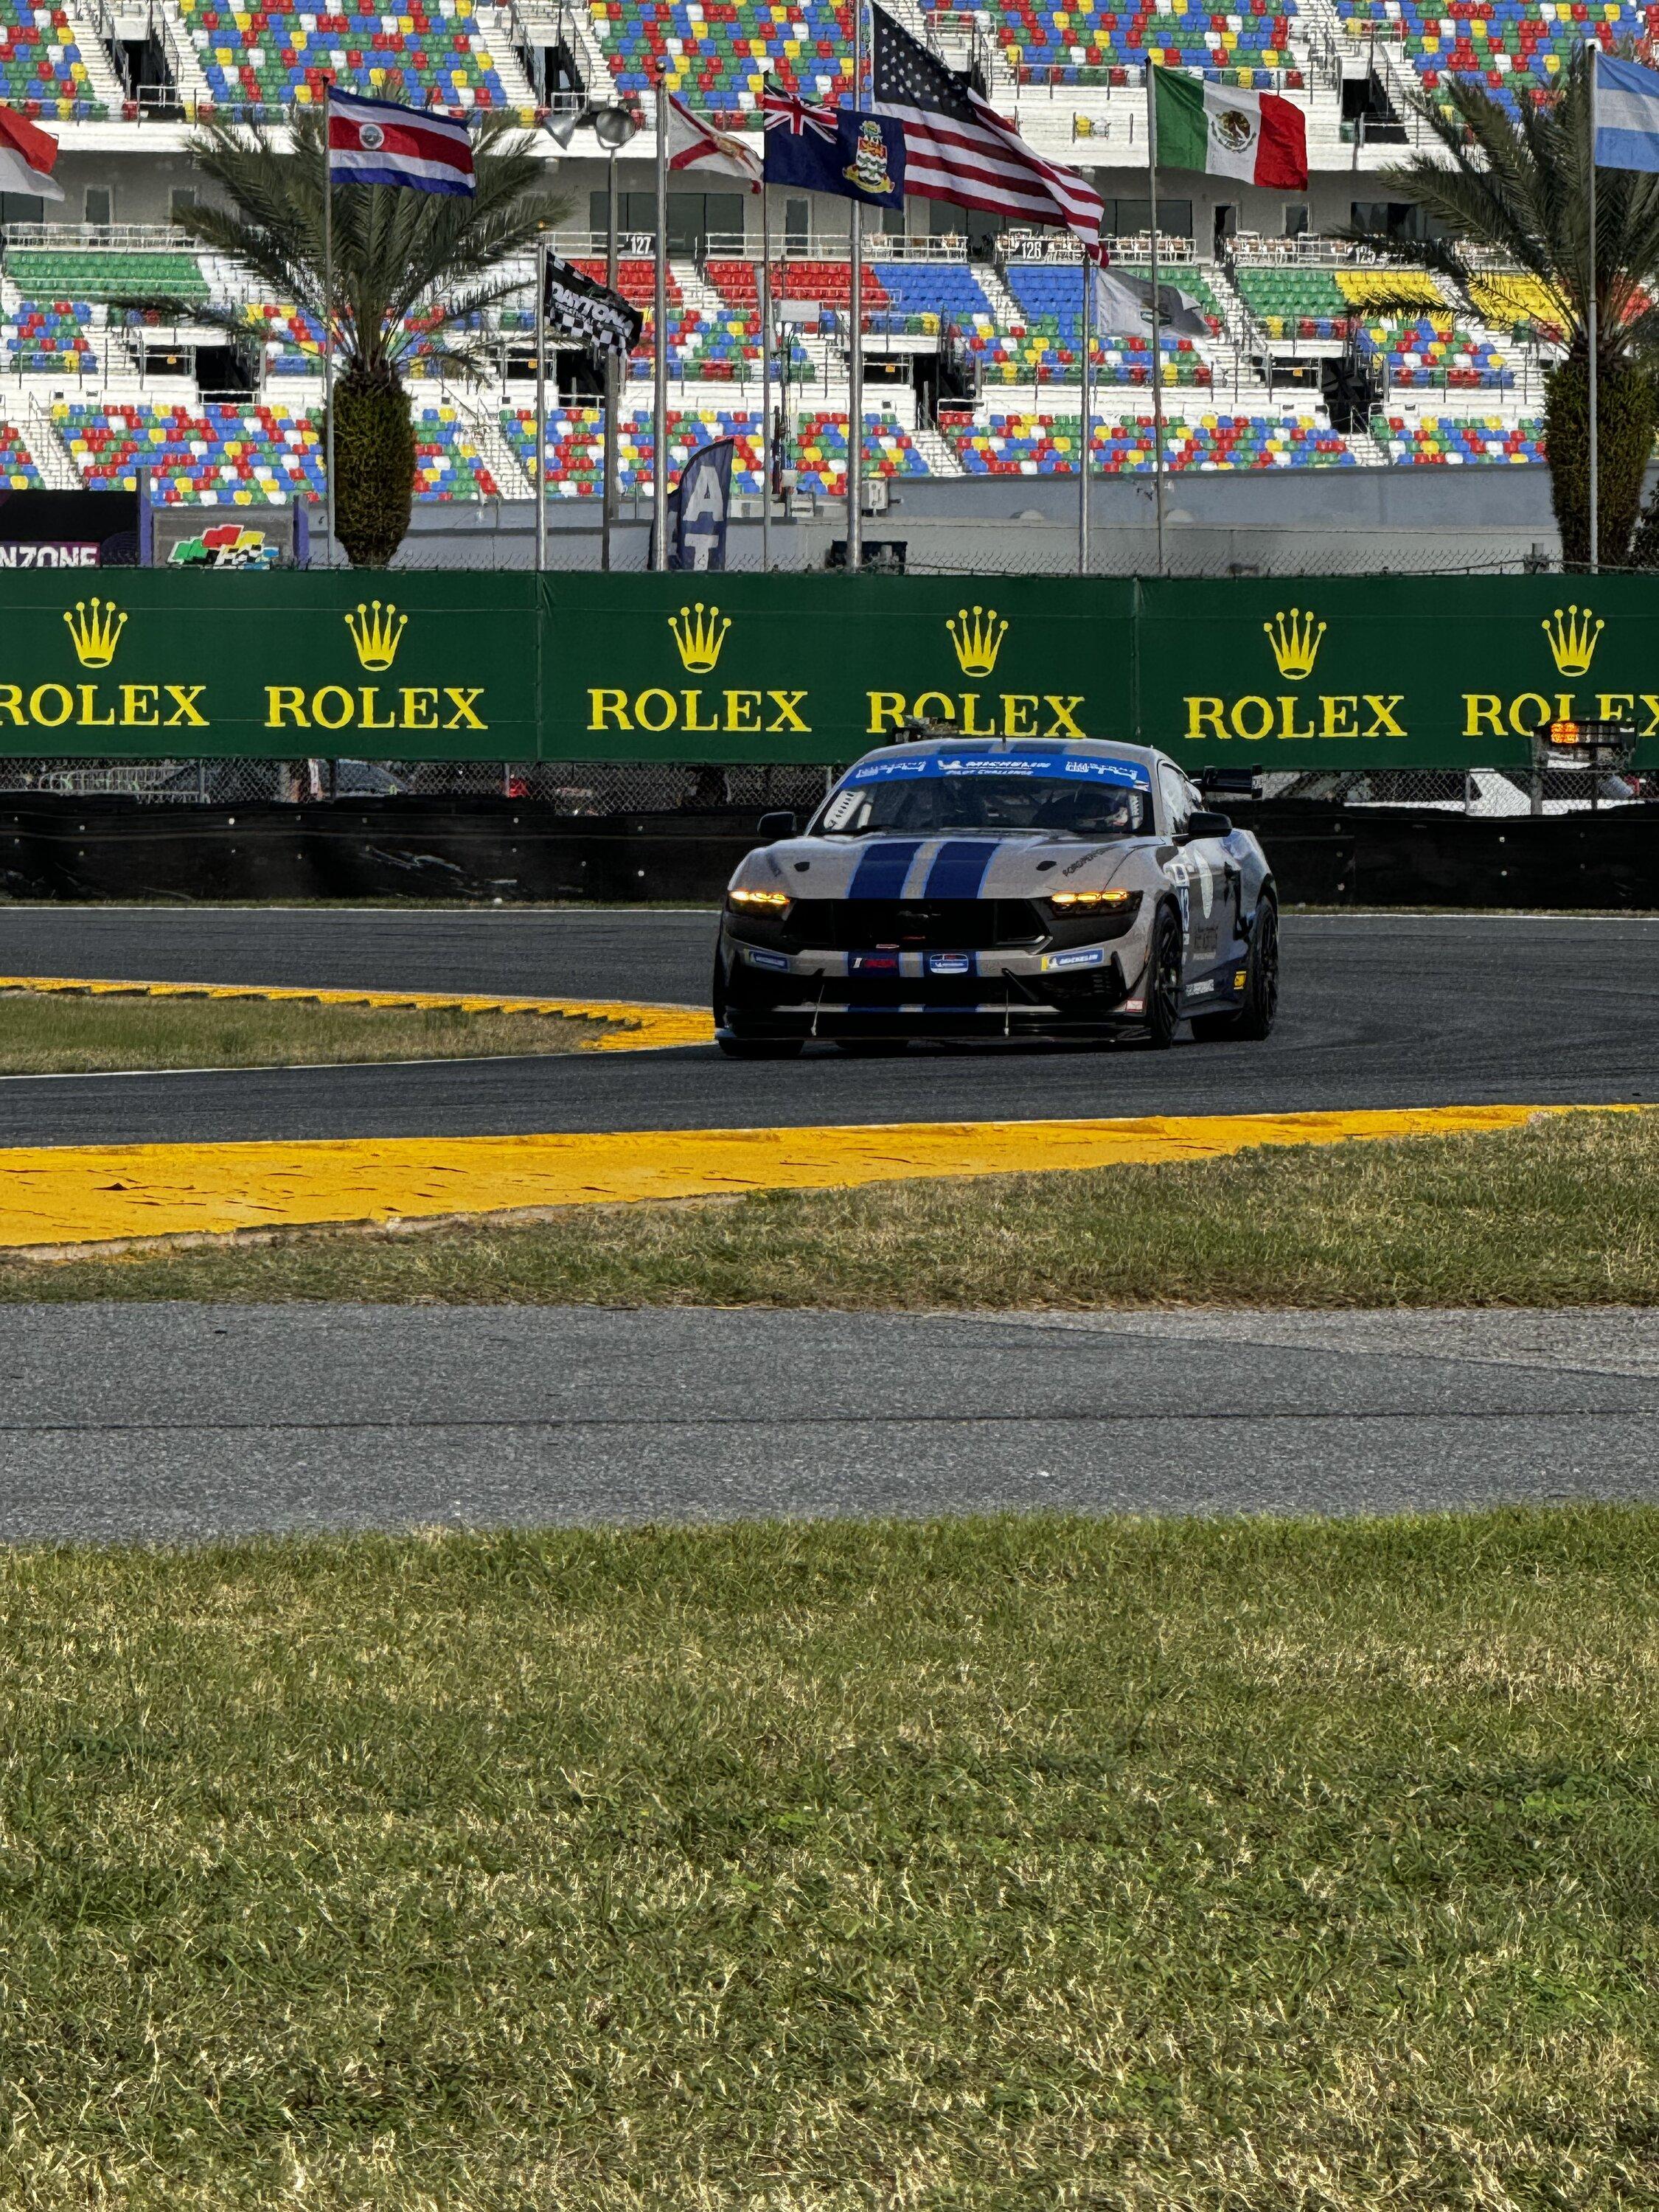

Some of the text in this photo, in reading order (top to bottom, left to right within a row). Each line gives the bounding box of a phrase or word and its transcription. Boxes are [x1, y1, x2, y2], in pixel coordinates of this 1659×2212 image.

[630, 235, 652, 255] 127
[1022, 241, 1042, 260] 126
[0, 683, 208, 727] ROLEX
[265, 685, 488, 729] ROLEX
[588, 688, 809, 732] ROLEX
[866, 691, 1087, 739] ROLEX
[1184, 695, 1408, 740] ROLEX
